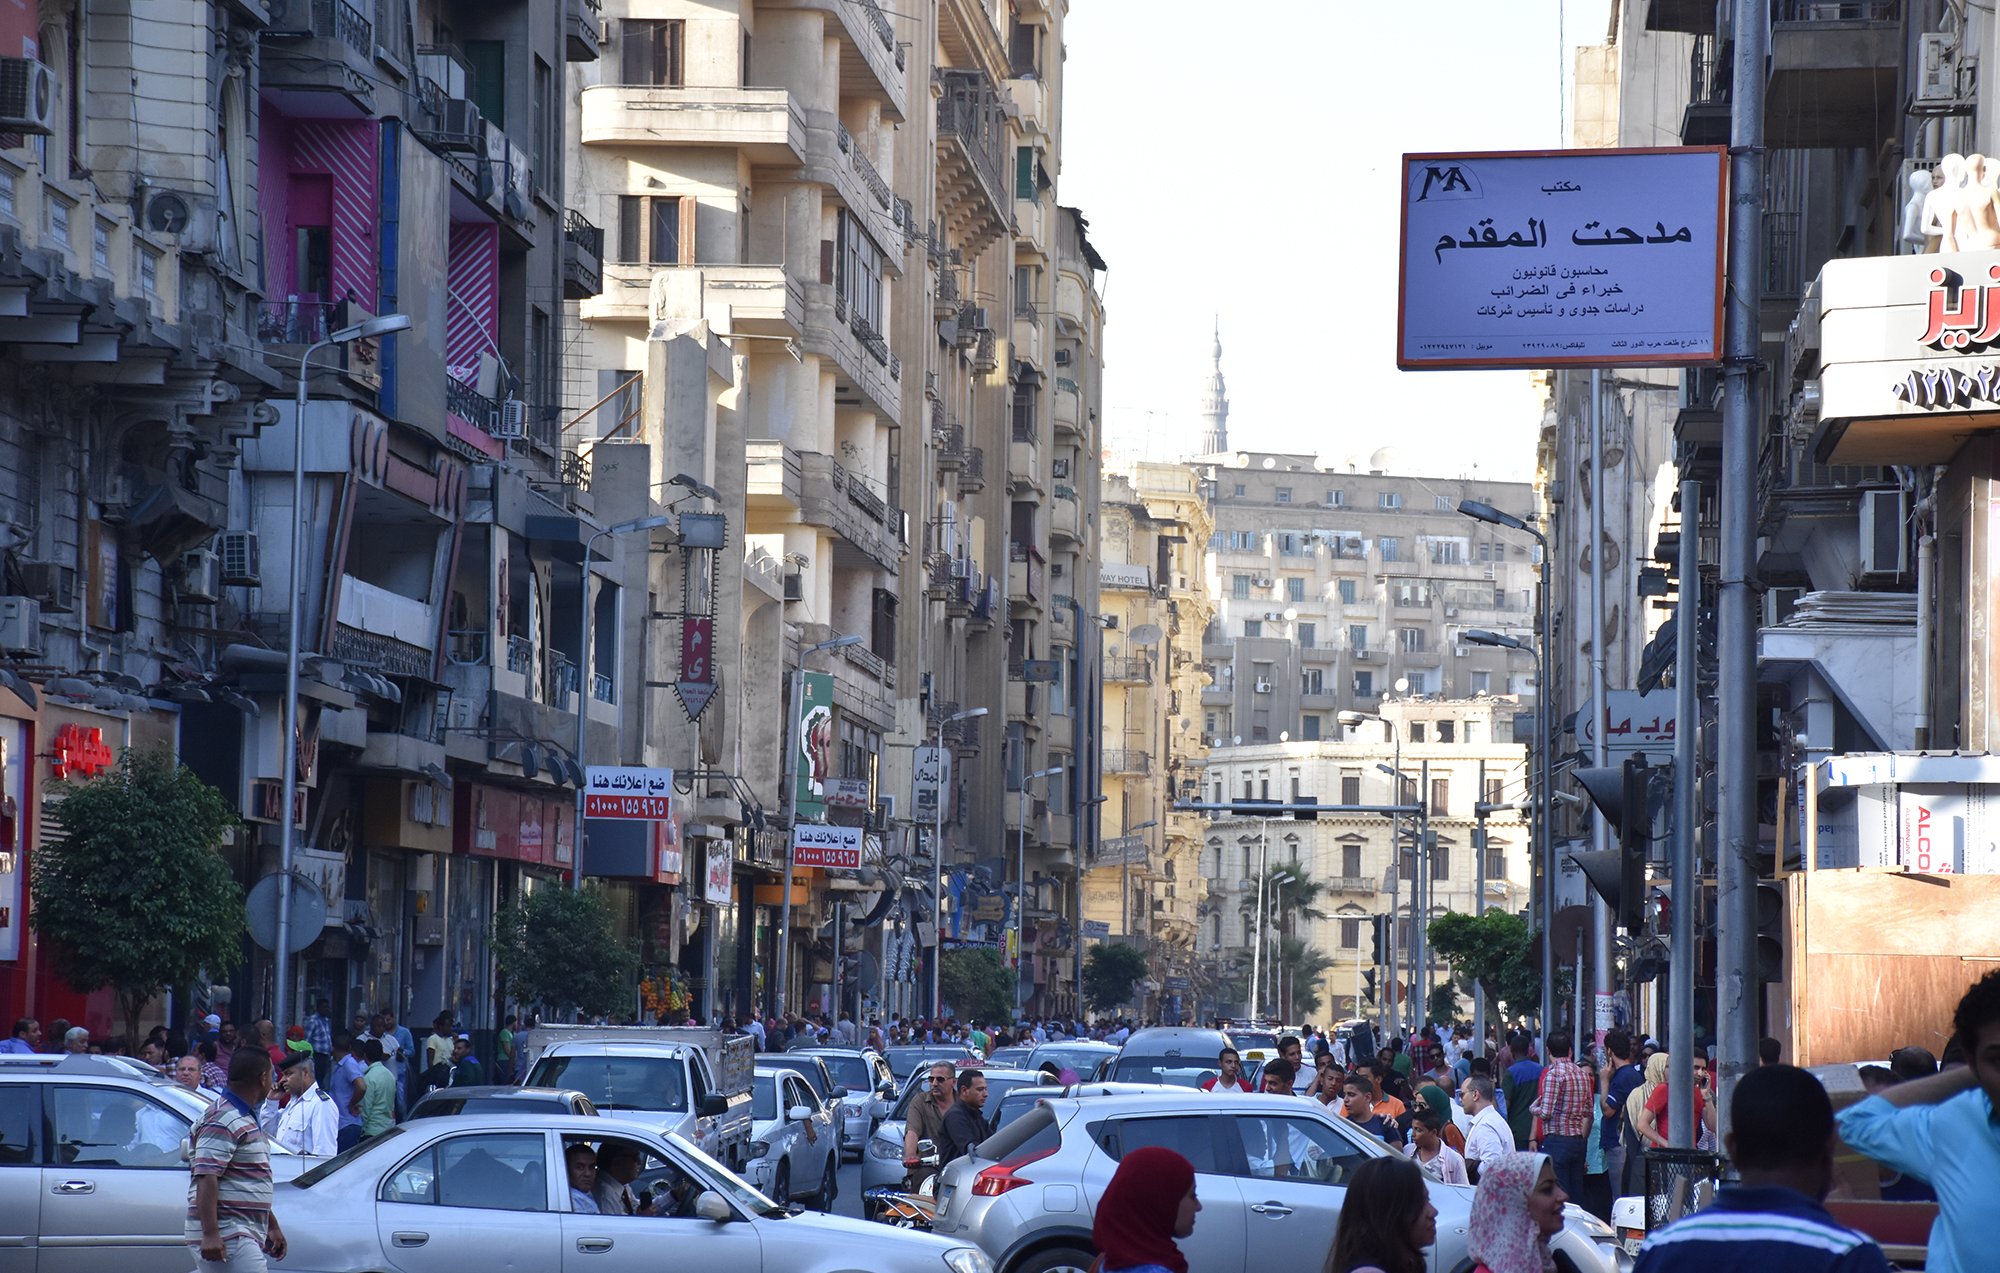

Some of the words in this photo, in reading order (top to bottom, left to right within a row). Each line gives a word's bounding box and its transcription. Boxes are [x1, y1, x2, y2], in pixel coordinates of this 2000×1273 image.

[1541, 181, 1581, 195] مكتب
[1434, 216, 1547, 265] المقدم
[1571, 220, 1692, 246] مدحت
[1512, 264, 1557, 280] قانونيون
[1560, 265, 1609, 279] محاسبون
[1490, 284, 1549, 299] الضرائب
[1555, 282, 1576, 299] فى
[1582, 283, 1624, 298] خبراء
[1476, 303, 1513, 319] شركات
[1516, 302, 1553, 318] تأسيس
[1557, 307, 1565, 317] و
[1568, 304, 1600, 317] جدوى
[1604, 303, 1645, 316] دراسات
[1630, 340, 1645, 349] الدور
[1663, 339, 1680, 347] طلعت
[1680, 339, 1698, 349] شارع
[1117, 575, 1146, 585] HOTEL
[592, 774, 610, 788] هنا
[611, 773, 646, 791] أعلانك
[648, 777, 665, 796] ضع
[590, 797, 618, 814] ٠١٠٠٠
[621, 797, 639, 815] ١٥٥
[641, 798, 665, 816] ٩٦٥
[799, 831, 813, 842] هنا
[814, 832, 842, 845] أعلانك
[842, 834, 857, 849] ضع
[822, 850, 836, 863] ١٥٥
[838, 850, 856, 865] ٩٦٥
